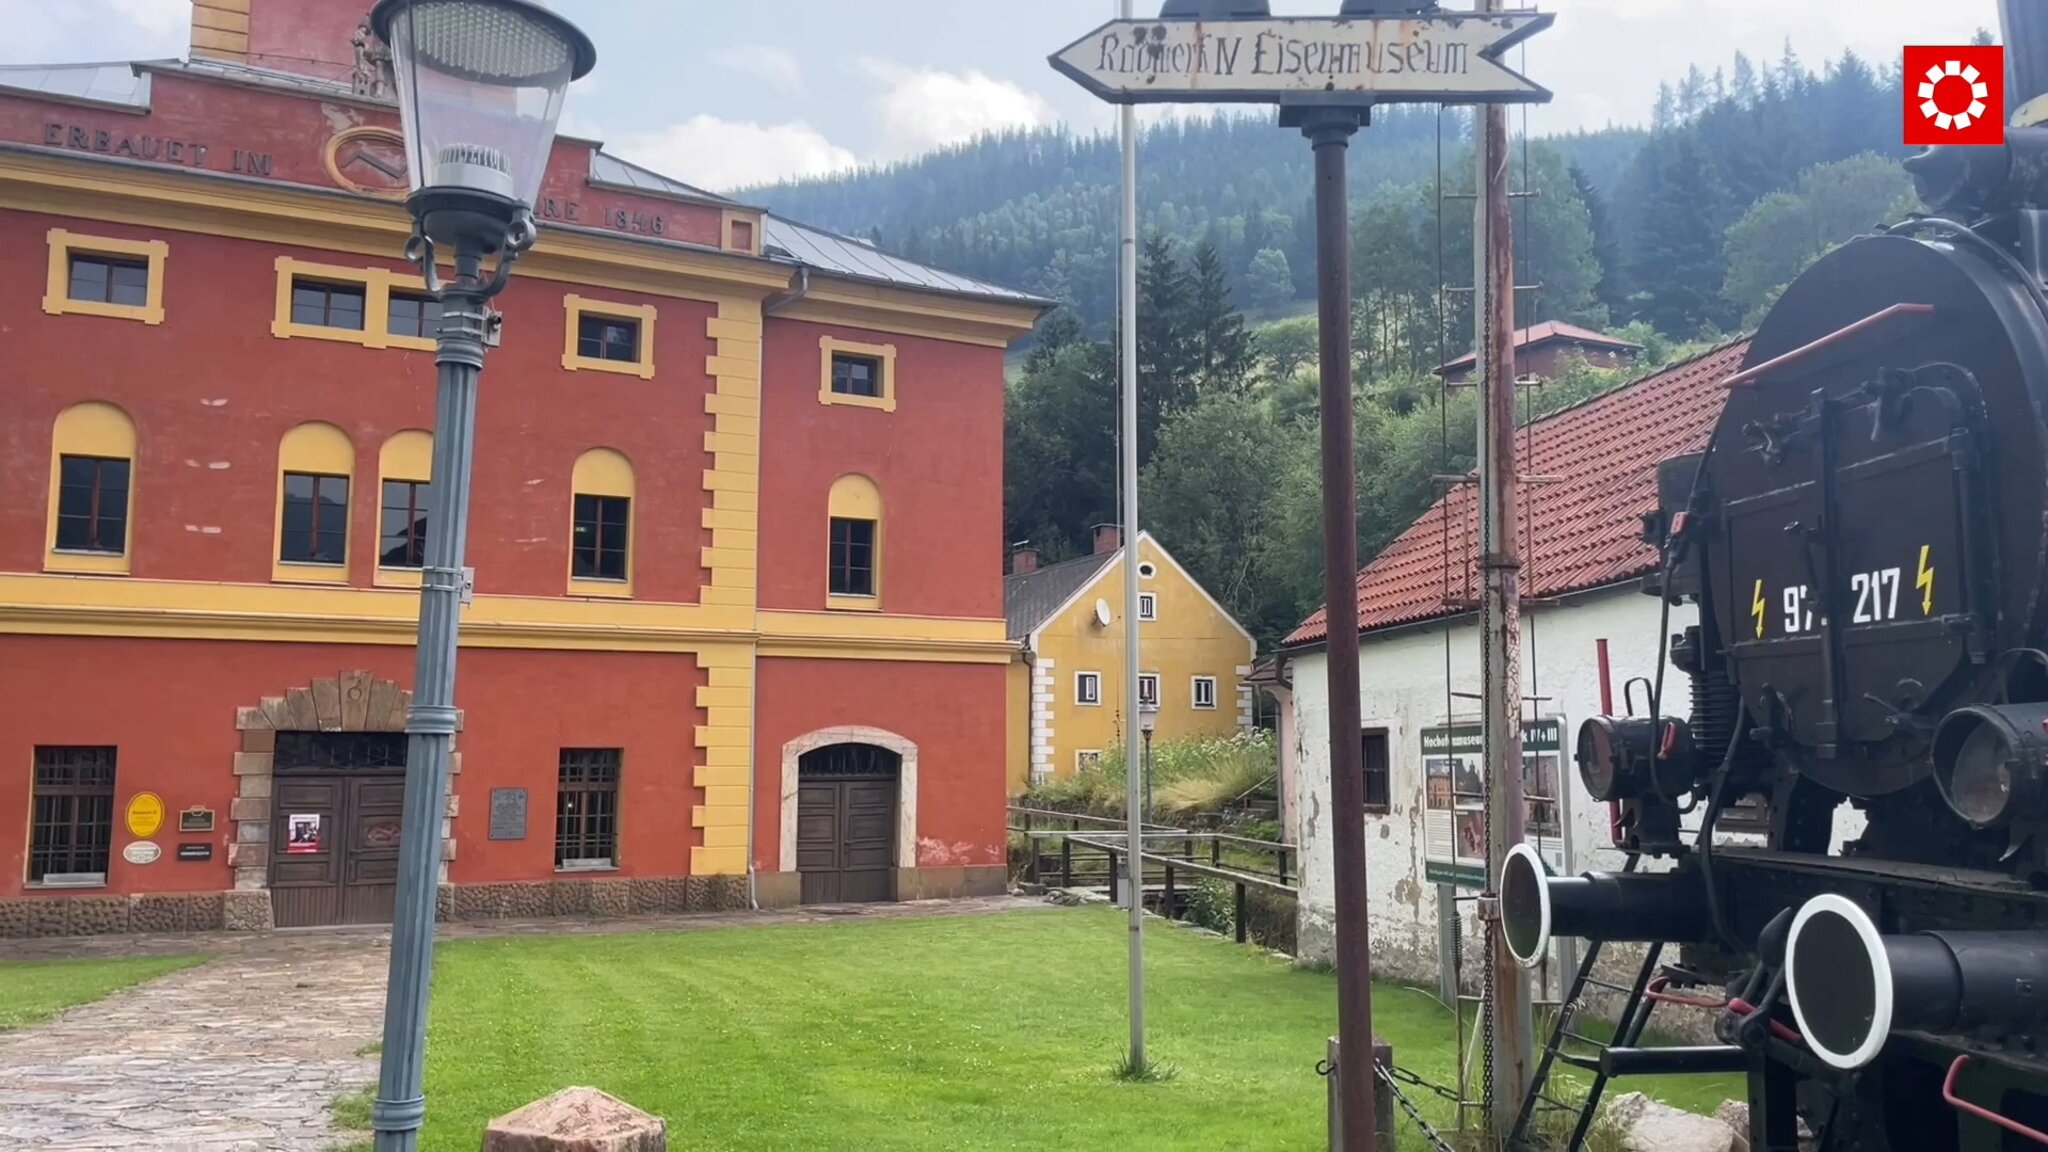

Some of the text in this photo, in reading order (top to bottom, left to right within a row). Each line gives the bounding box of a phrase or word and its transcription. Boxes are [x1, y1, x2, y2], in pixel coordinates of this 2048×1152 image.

[1250, 28, 1469, 75] Eisenmuseum
[43, 122, 208, 166] ERBAUET
[232, 149, 273, 176] IM
[603, 207, 665, 235] 1846
